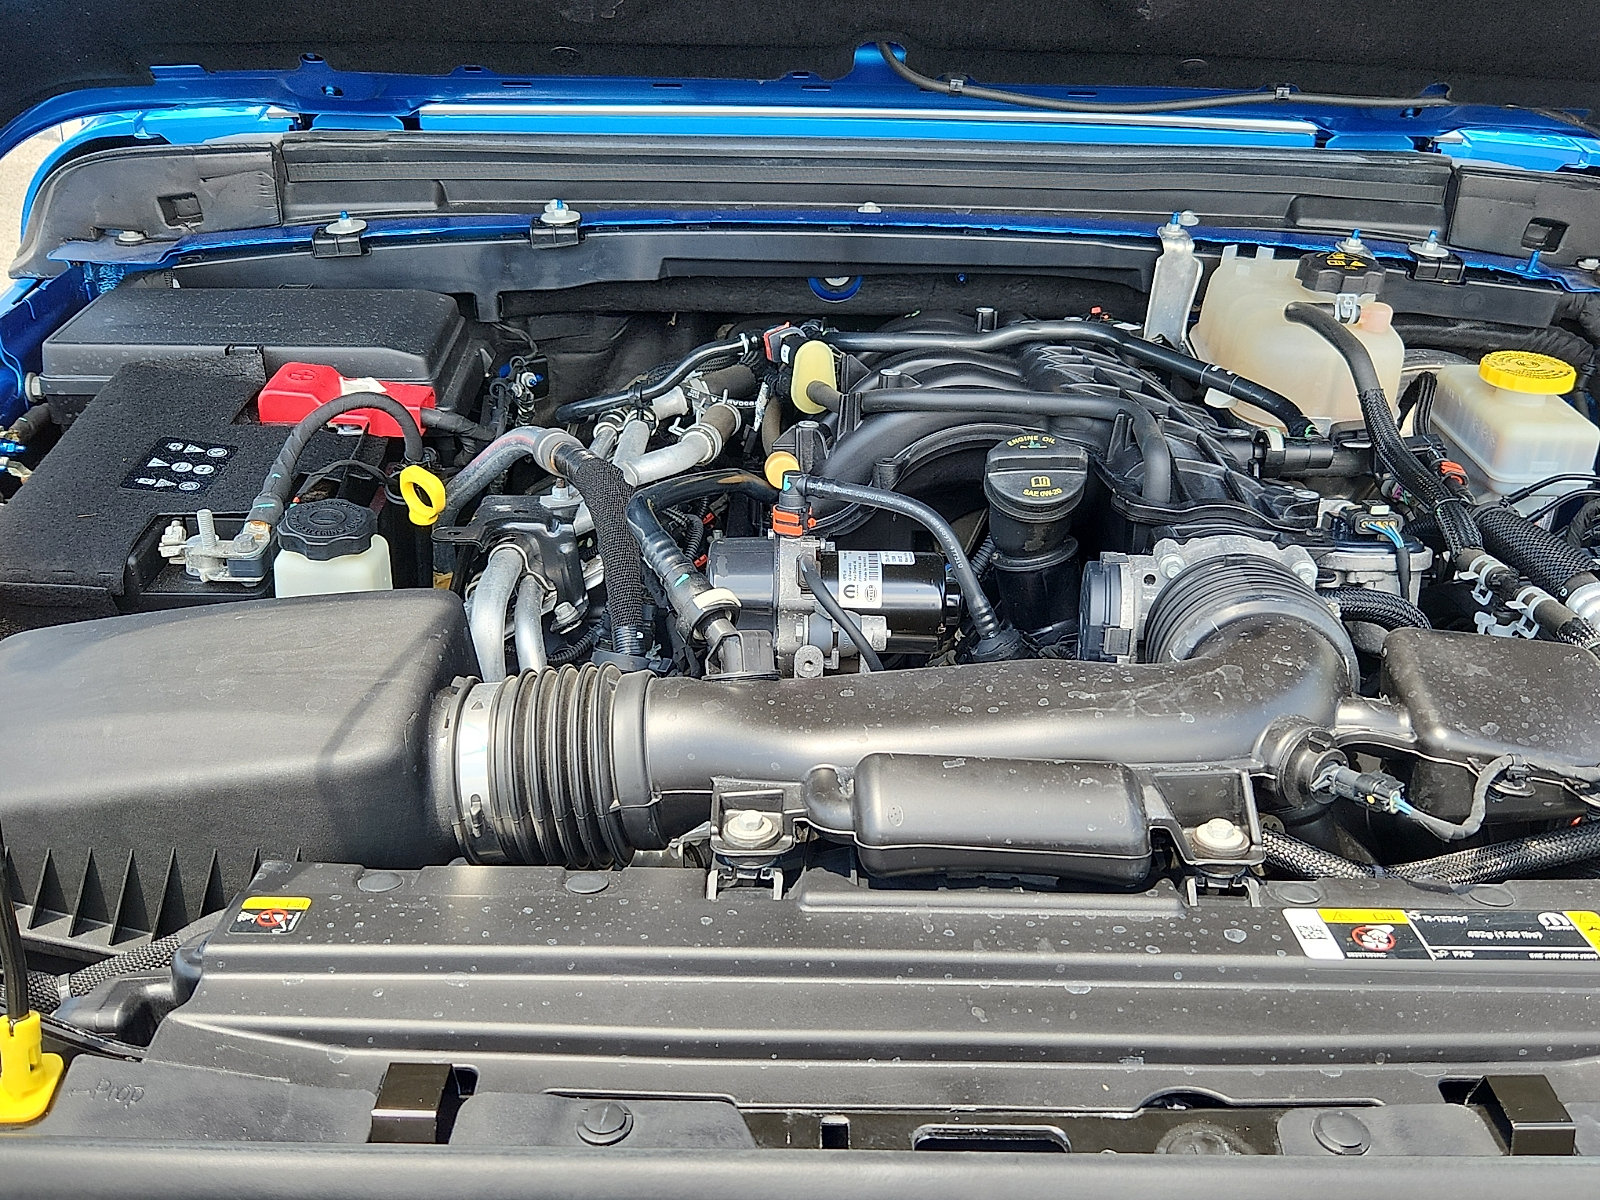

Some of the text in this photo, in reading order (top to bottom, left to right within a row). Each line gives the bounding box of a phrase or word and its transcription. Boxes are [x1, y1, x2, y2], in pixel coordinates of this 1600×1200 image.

[1007, 435, 1056, 447] ENGINE OIL
[1023, 489, 1039, 497] SAE
